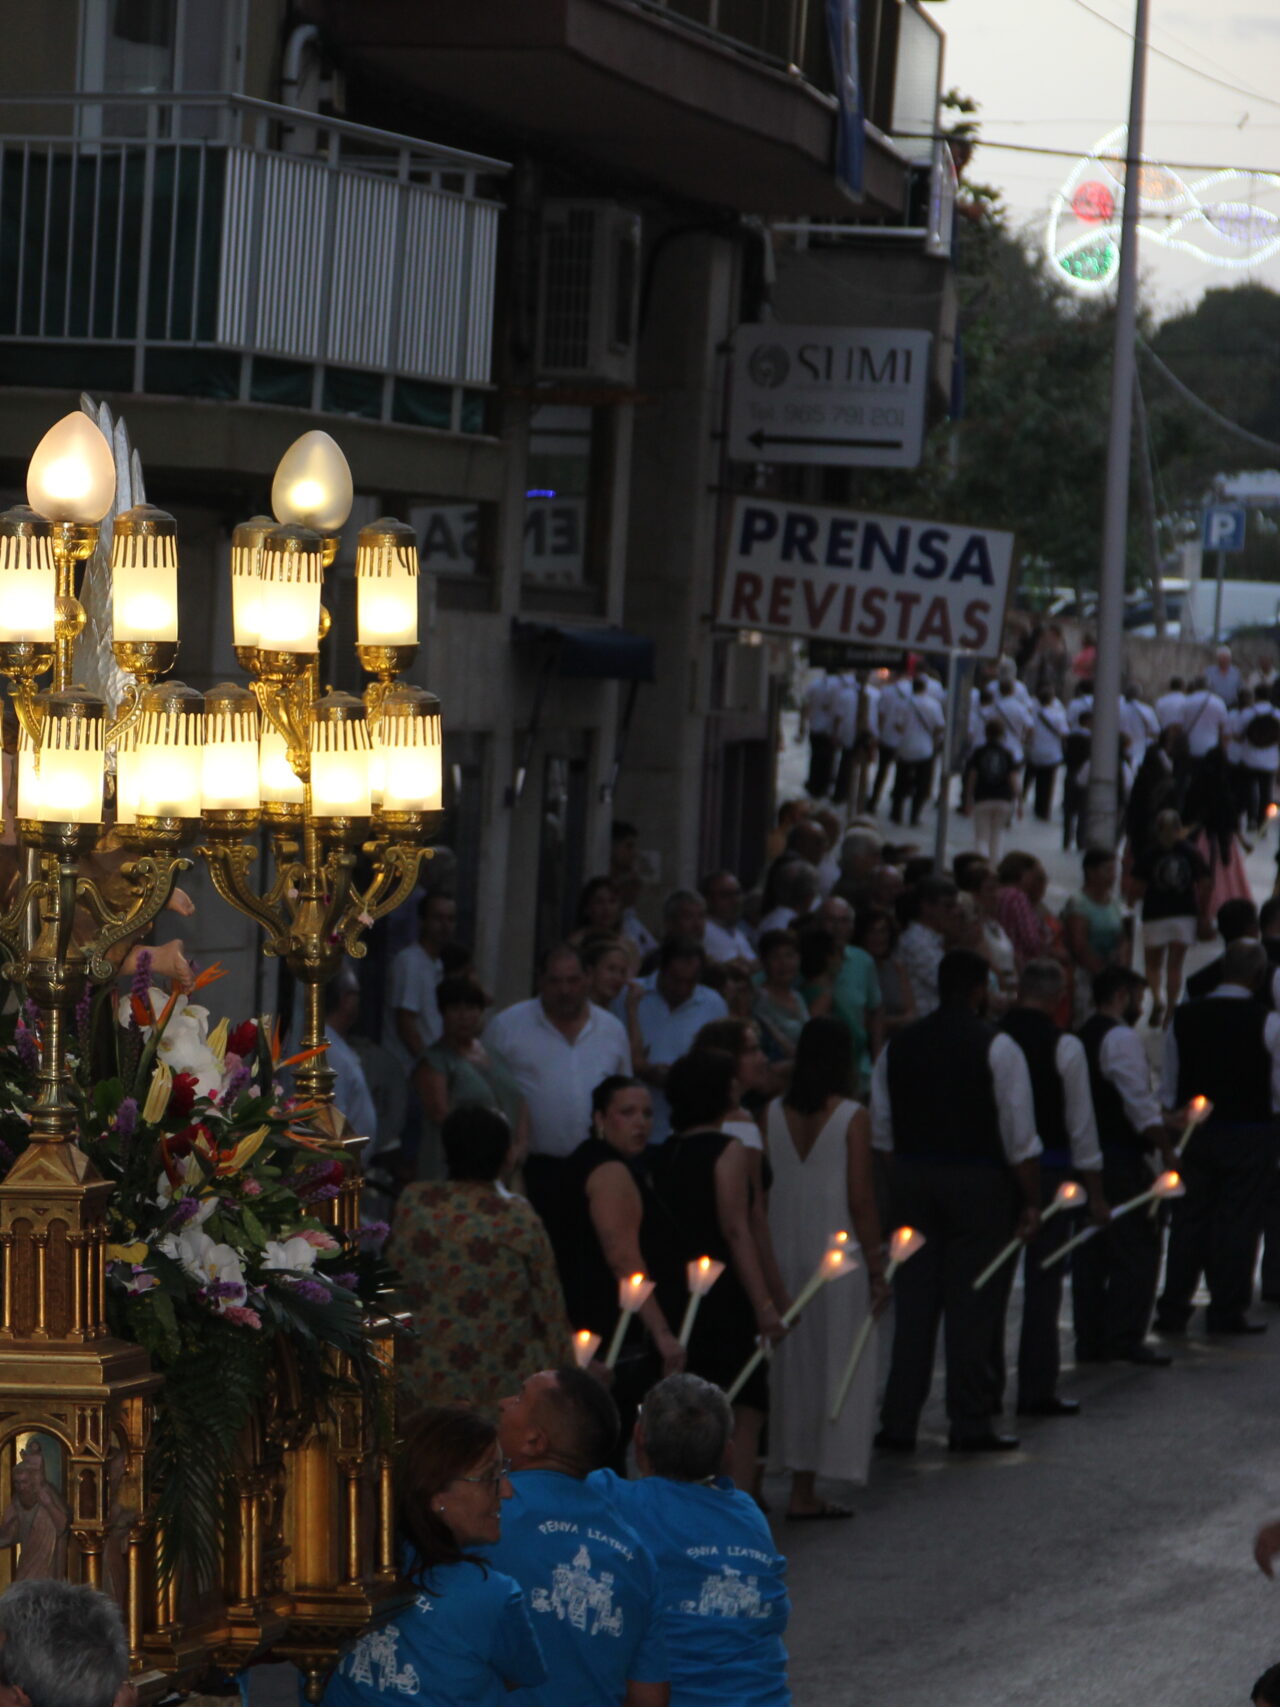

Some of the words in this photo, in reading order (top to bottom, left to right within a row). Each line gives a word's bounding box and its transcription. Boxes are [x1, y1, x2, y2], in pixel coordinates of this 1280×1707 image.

[739, 507, 995, 585] PRENSA
[1210, 512, 1237, 546] P
[730, 571, 992, 650] REVISTAS
[538, 1519, 579, 1536] PENYA
